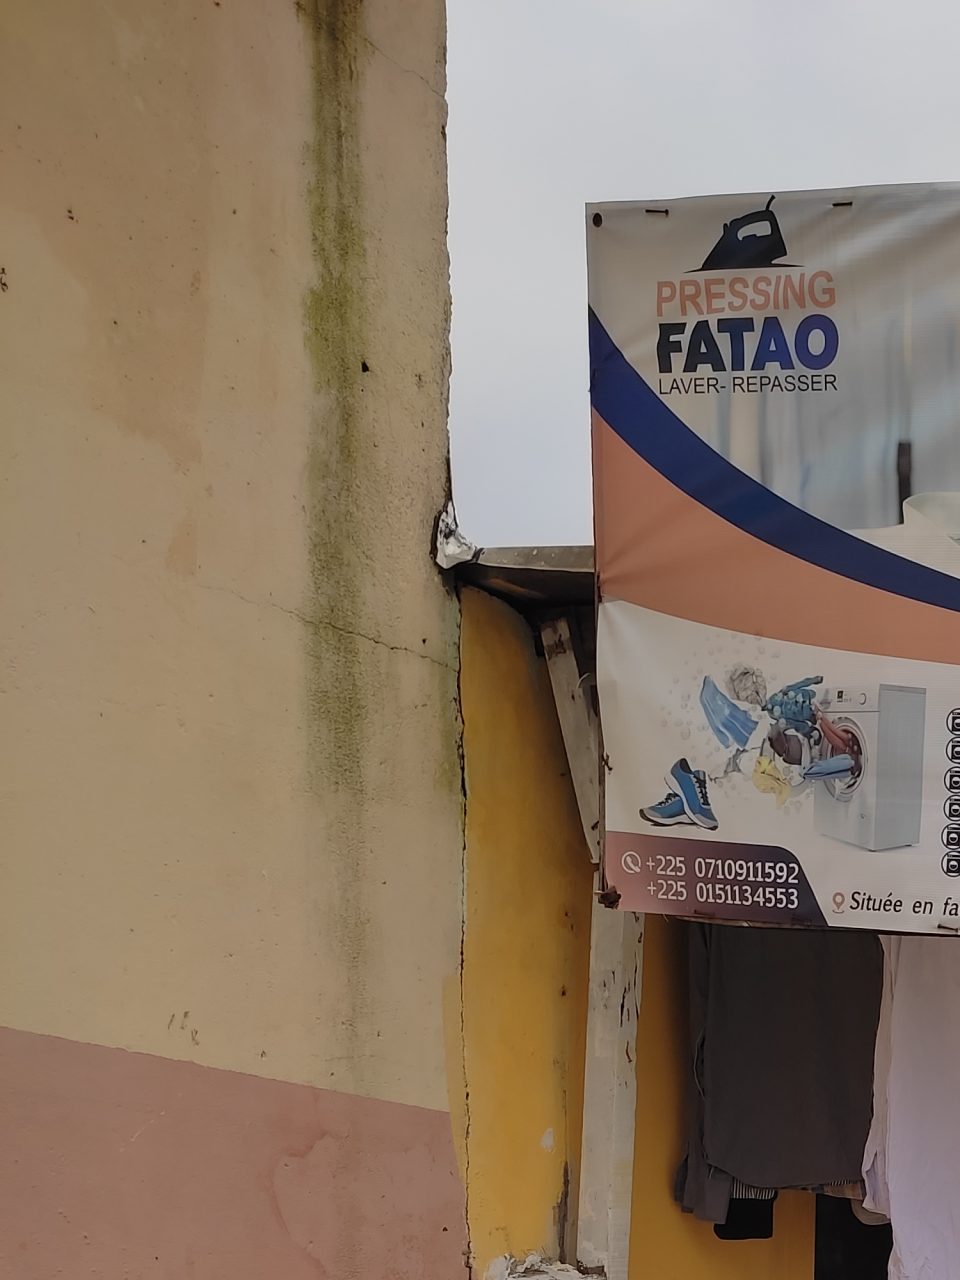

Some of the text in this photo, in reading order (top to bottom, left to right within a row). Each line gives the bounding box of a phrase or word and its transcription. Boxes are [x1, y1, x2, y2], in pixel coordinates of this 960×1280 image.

[656, 270, 836, 317] PRESSING
[656, 313, 839, 374] FATAO
[659, 374, 838, 394] LAVER- REPASSER
[646, 855, 799, 884] +225 0710911592
[647, 879, 799, 909] +225 0151134553
[849, 891, 903, 913] Située
[912, 900, 934, 915] en
